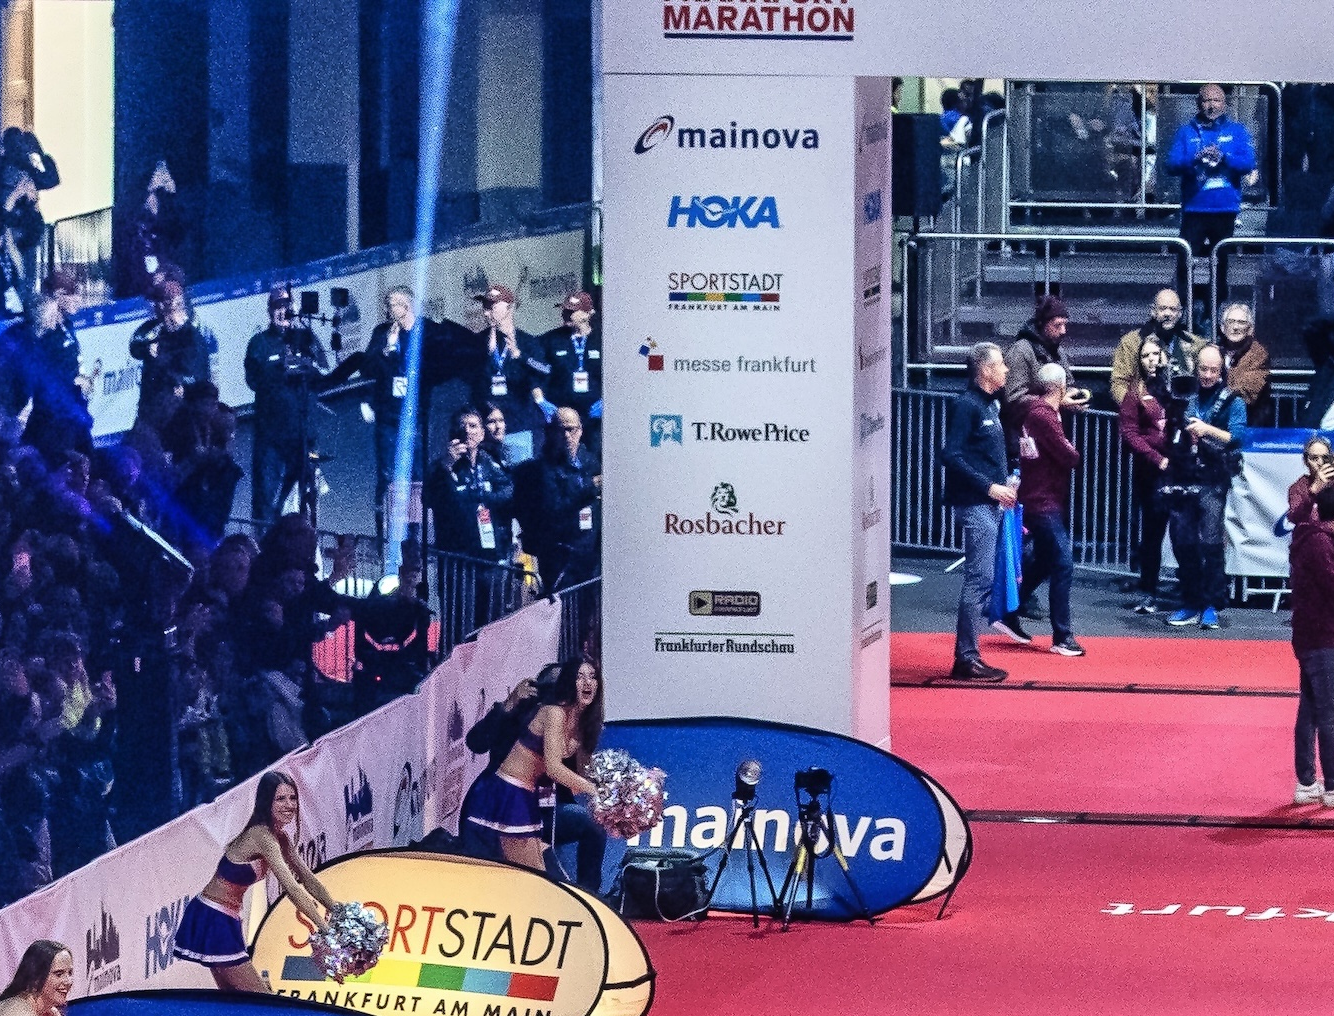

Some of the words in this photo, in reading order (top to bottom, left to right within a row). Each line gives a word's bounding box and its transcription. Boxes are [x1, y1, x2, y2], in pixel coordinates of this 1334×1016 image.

[664, 5, 854, 32] MARATHON
[678, 122, 819, 149] mainova
[667, 196, 780, 228] HOKA
[669, 272, 783, 290] SPORTSTADT
[668, 303, 727, 311] FRANKFURT
[674, 359, 731, 372] messe
[737, 356, 817, 373] frankfurt
[664, 513, 787, 536] Rosbacher
[288, 900, 582, 970] SRTSTADT
